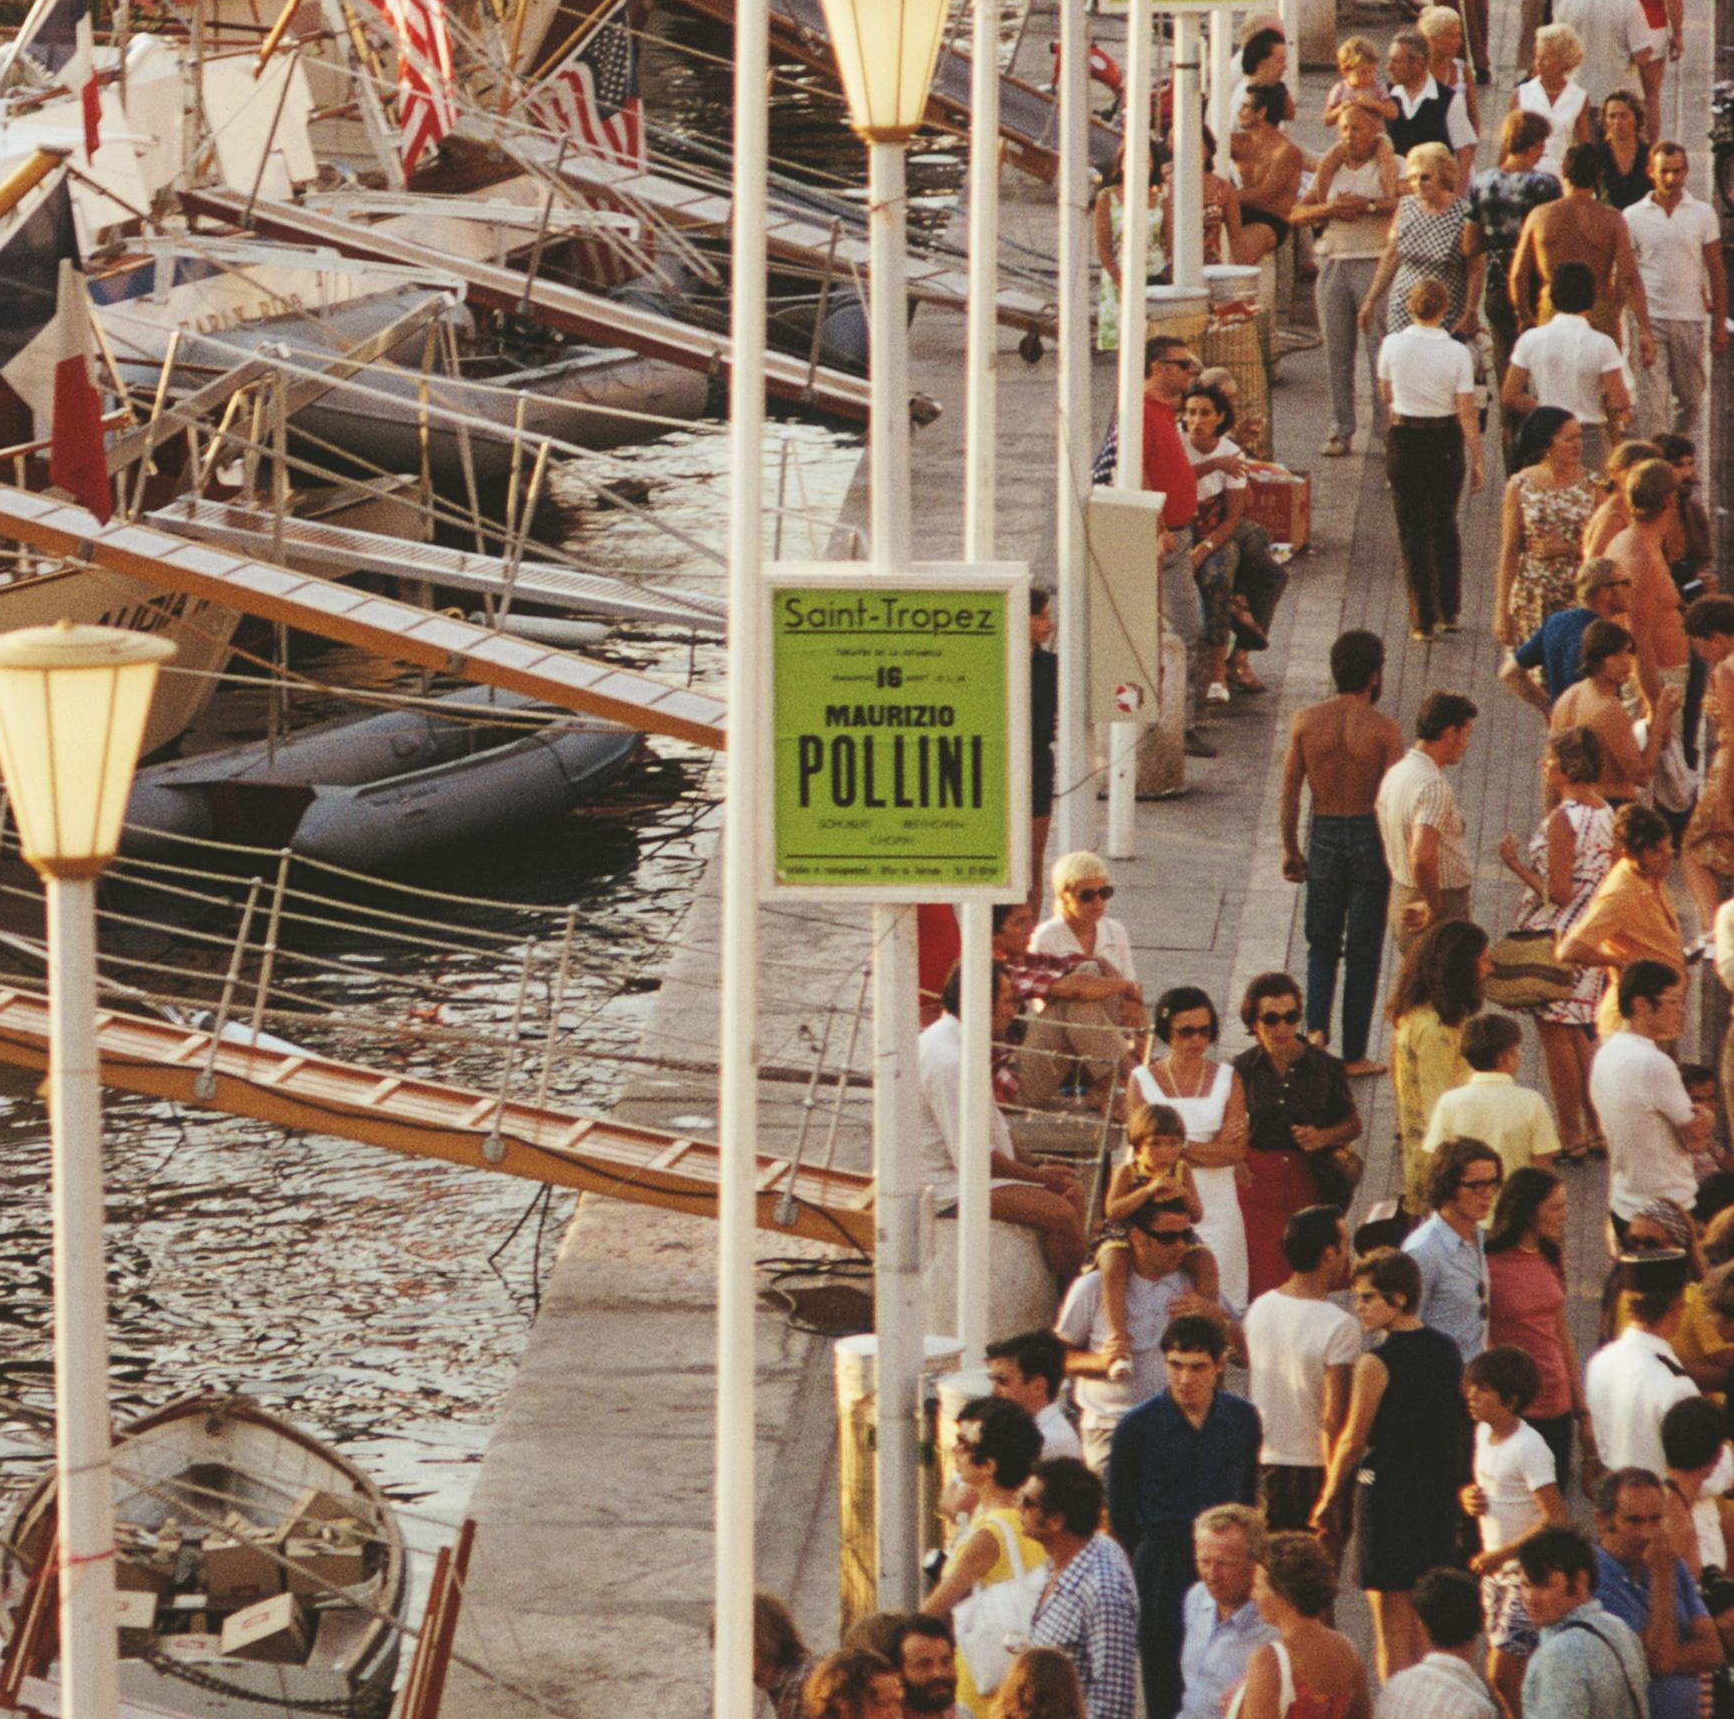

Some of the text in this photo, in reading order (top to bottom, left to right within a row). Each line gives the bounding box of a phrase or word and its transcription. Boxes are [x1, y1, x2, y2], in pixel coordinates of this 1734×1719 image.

[784, 597, 996, 636] Saint-Tropez
[876, 665, 904, 689] 16
[824, 704, 956, 728] MAURIZIO
[798, 733, 983, 810] POLLINI
